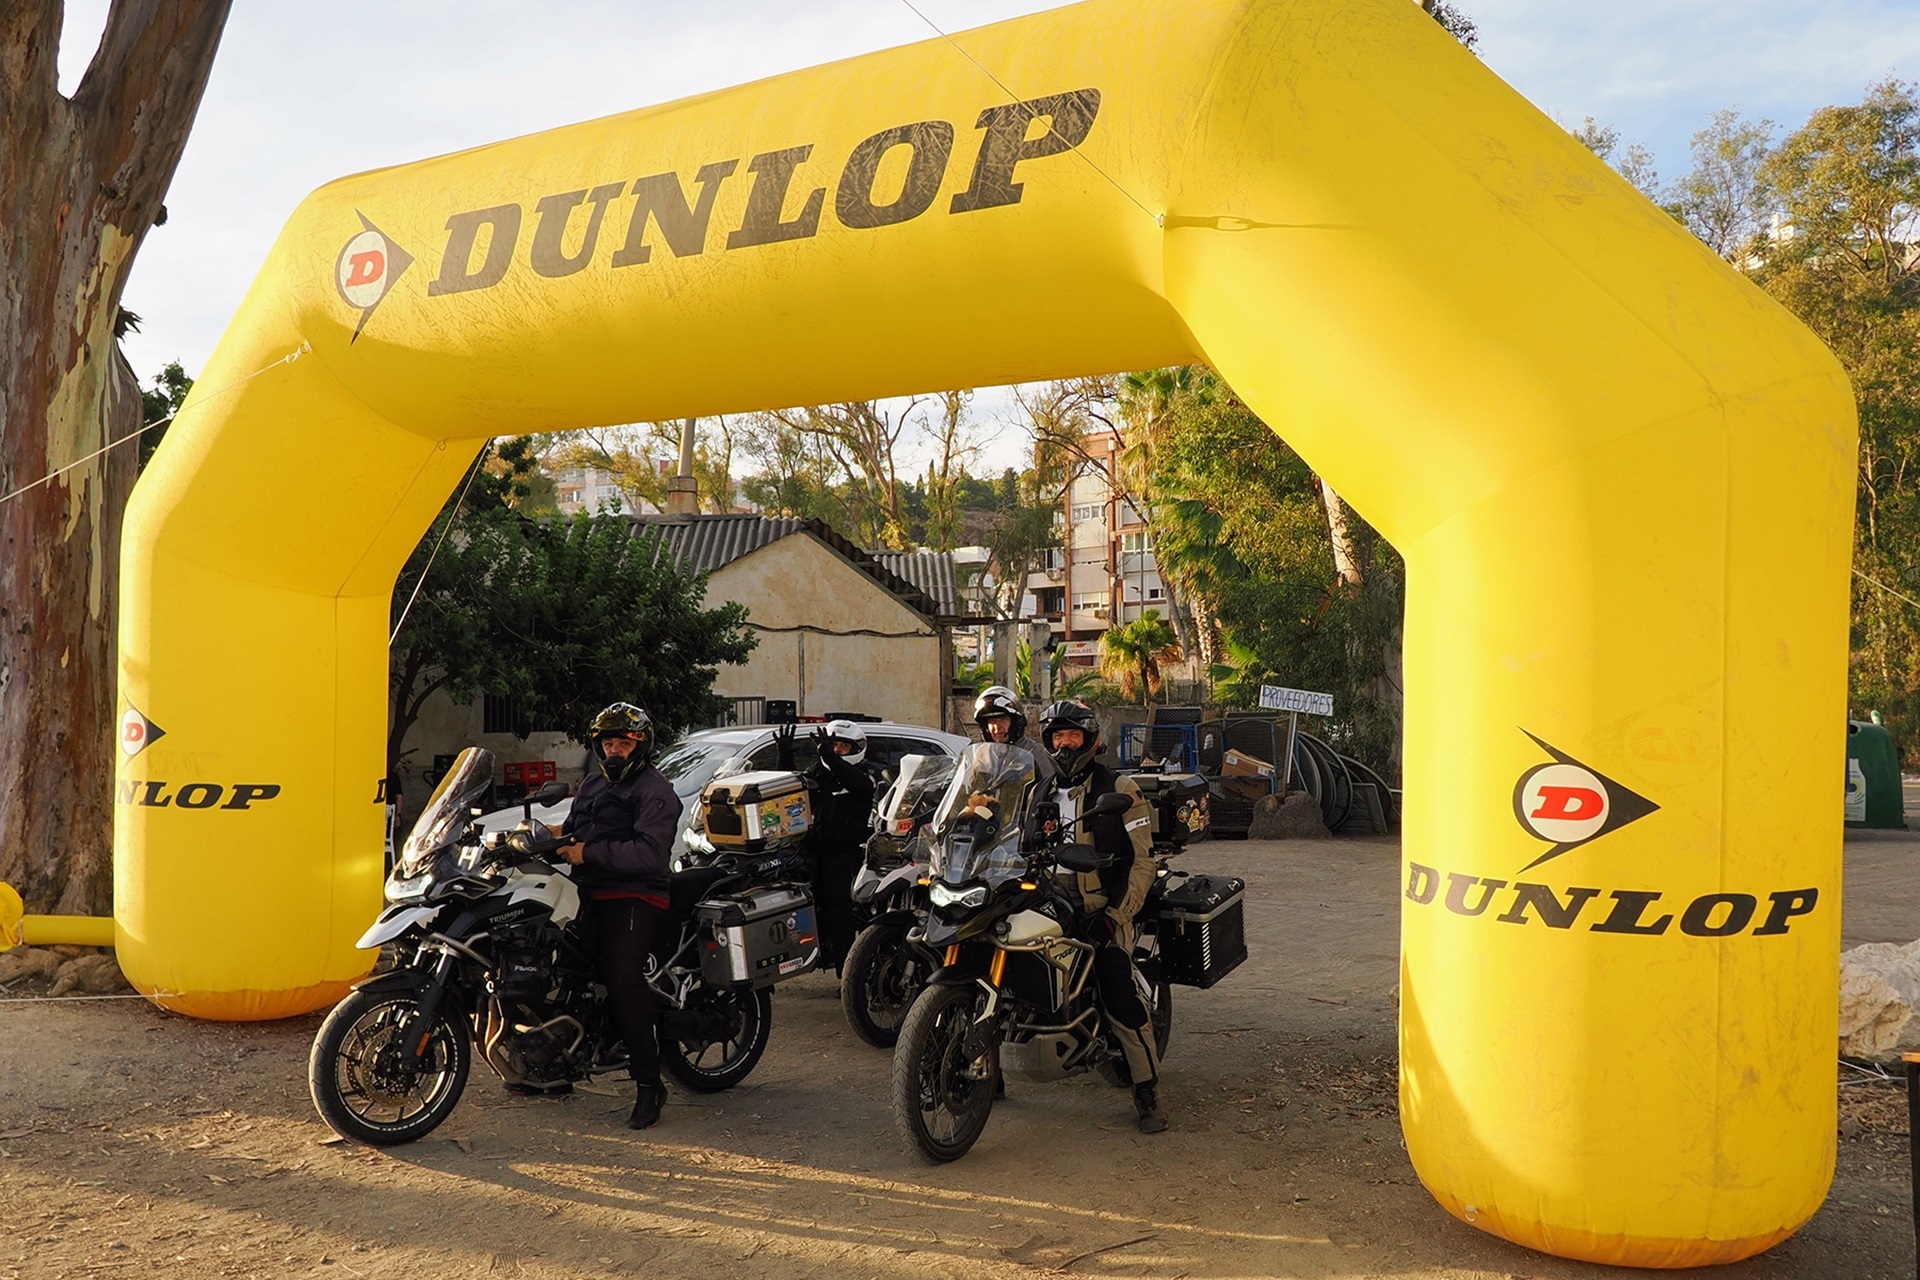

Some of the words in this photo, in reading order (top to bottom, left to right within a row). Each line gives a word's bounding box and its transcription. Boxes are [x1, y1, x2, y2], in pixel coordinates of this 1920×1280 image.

[345, 250, 385, 288] D
[427, 87, 1102, 297] DUNLOP
[1262, 686, 1333, 715] PROVEEDORES
[124, 722, 144, 742] D
[117, 779, 282, 810] NLOP
[1530, 785, 1605, 821] D
[1405, 861, 1819, 937] DUNLOP
[488, 908, 525, 924] TRIUMPH
